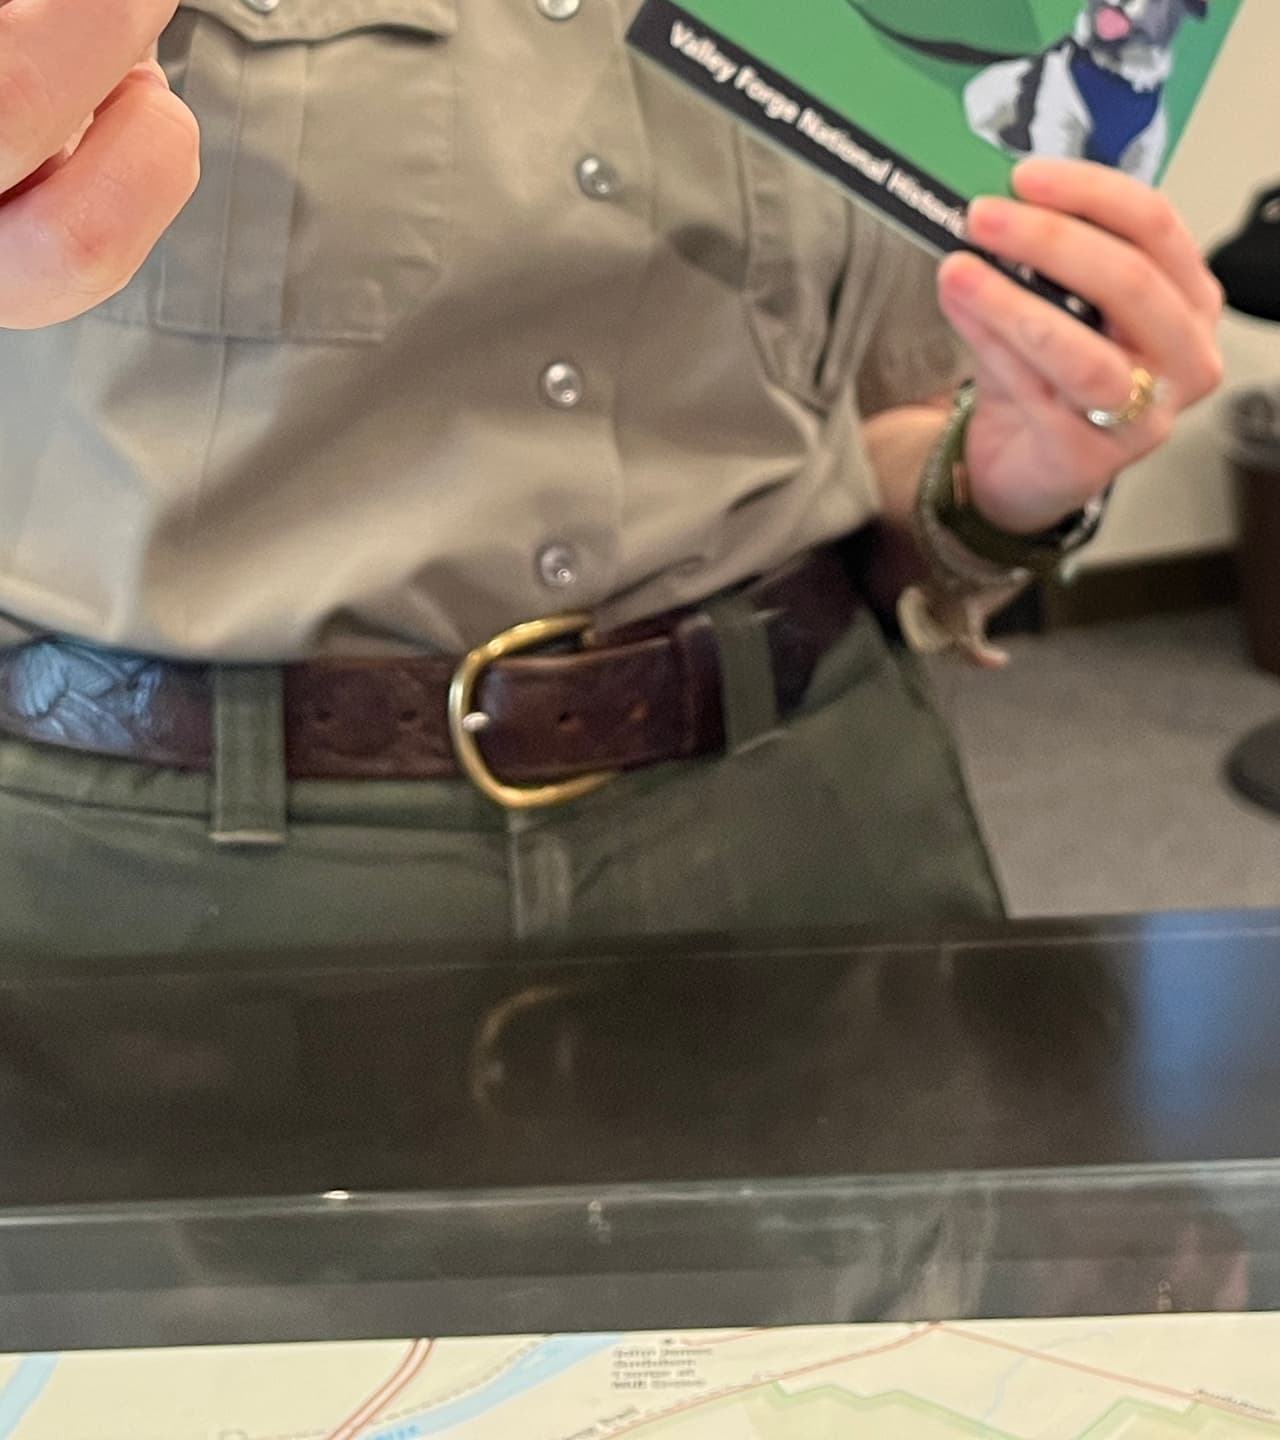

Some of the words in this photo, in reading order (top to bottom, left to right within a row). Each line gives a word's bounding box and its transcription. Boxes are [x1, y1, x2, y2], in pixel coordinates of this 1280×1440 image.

[670, 20, 737, 83] Valley
[734, 65, 801, 124] Forge
[796, 107, 894, 186] National
